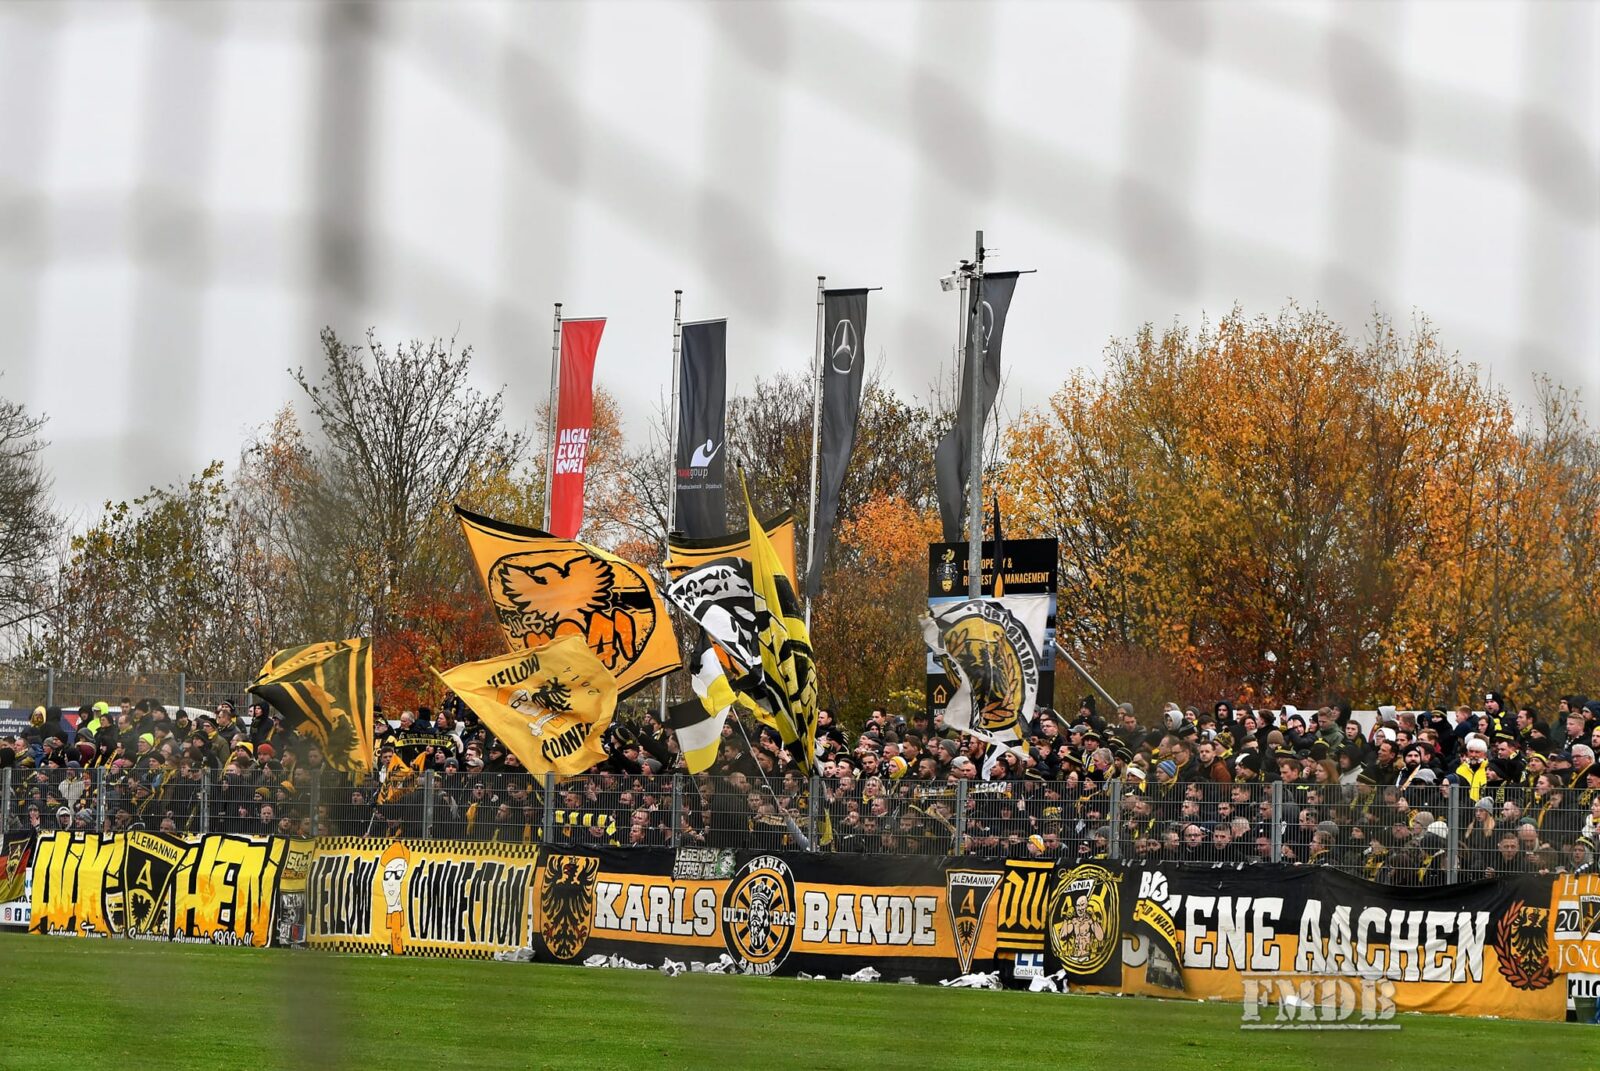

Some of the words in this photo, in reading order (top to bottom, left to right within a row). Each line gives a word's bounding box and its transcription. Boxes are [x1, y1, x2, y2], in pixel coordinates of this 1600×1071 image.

[1004, 572, 1050, 585] MANAGEMENT
[487, 654, 540, 688] YELLOW
[130, 830, 179, 861] ALEMANNIA
[748, 856, 787, 876] KARLS
[951, 875, 996, 887] ALEMANNIA
[308, 856, 380, 936] YELLOW
[408, 859, 533, 948] CONNECTION
[594, 882, 718, 937] KARLS
[802, 890, 937, 946] BANDE
[1295, 899, 1491, 983] AACHEN
[739, 957, 778, 976] BANDE
[1016, 968, 1033, 976] GmbH
